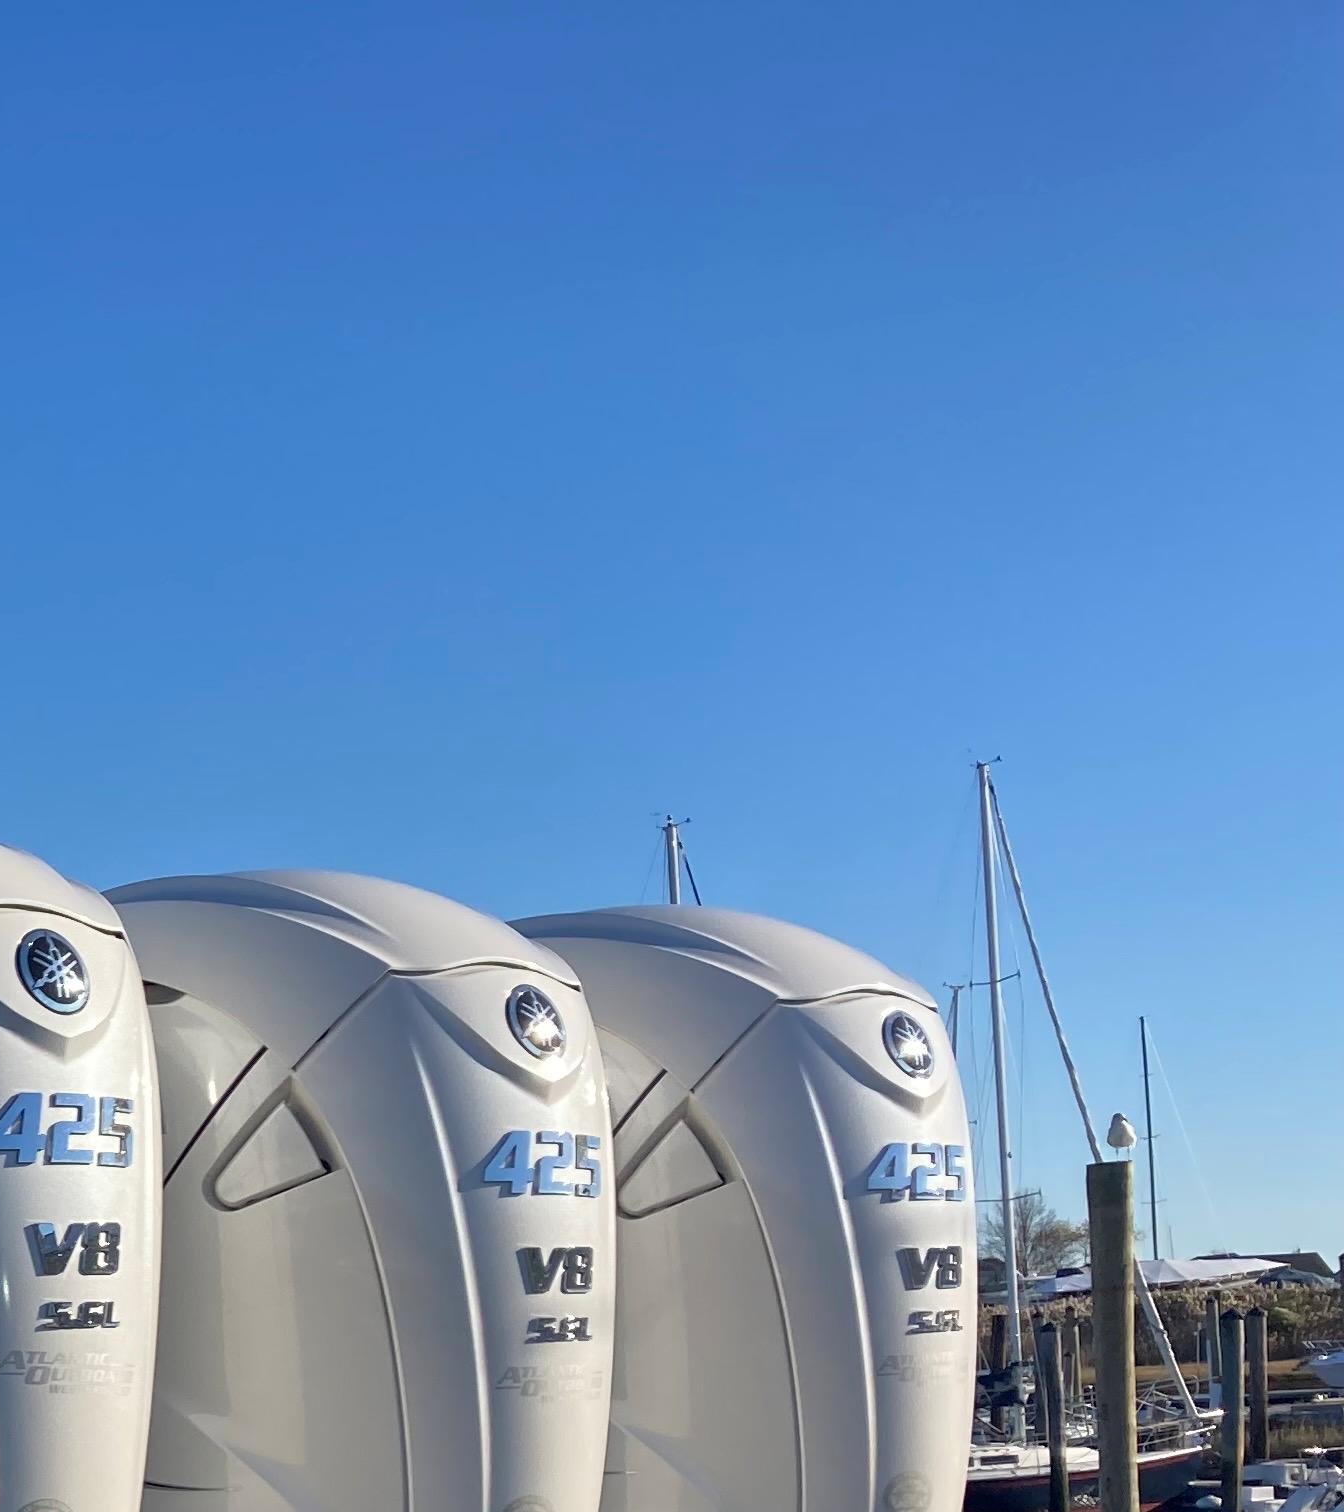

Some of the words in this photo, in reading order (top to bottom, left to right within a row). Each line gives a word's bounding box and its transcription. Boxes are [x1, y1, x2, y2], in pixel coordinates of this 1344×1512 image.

[483, 1130, 602, 1198] 425
[867, 1142, 967, 1202] 425
[23, 1222, 122, 1277] V8
[516, 1246, 594, 1295] V8
[895, 1245, 963, 1291] V8
